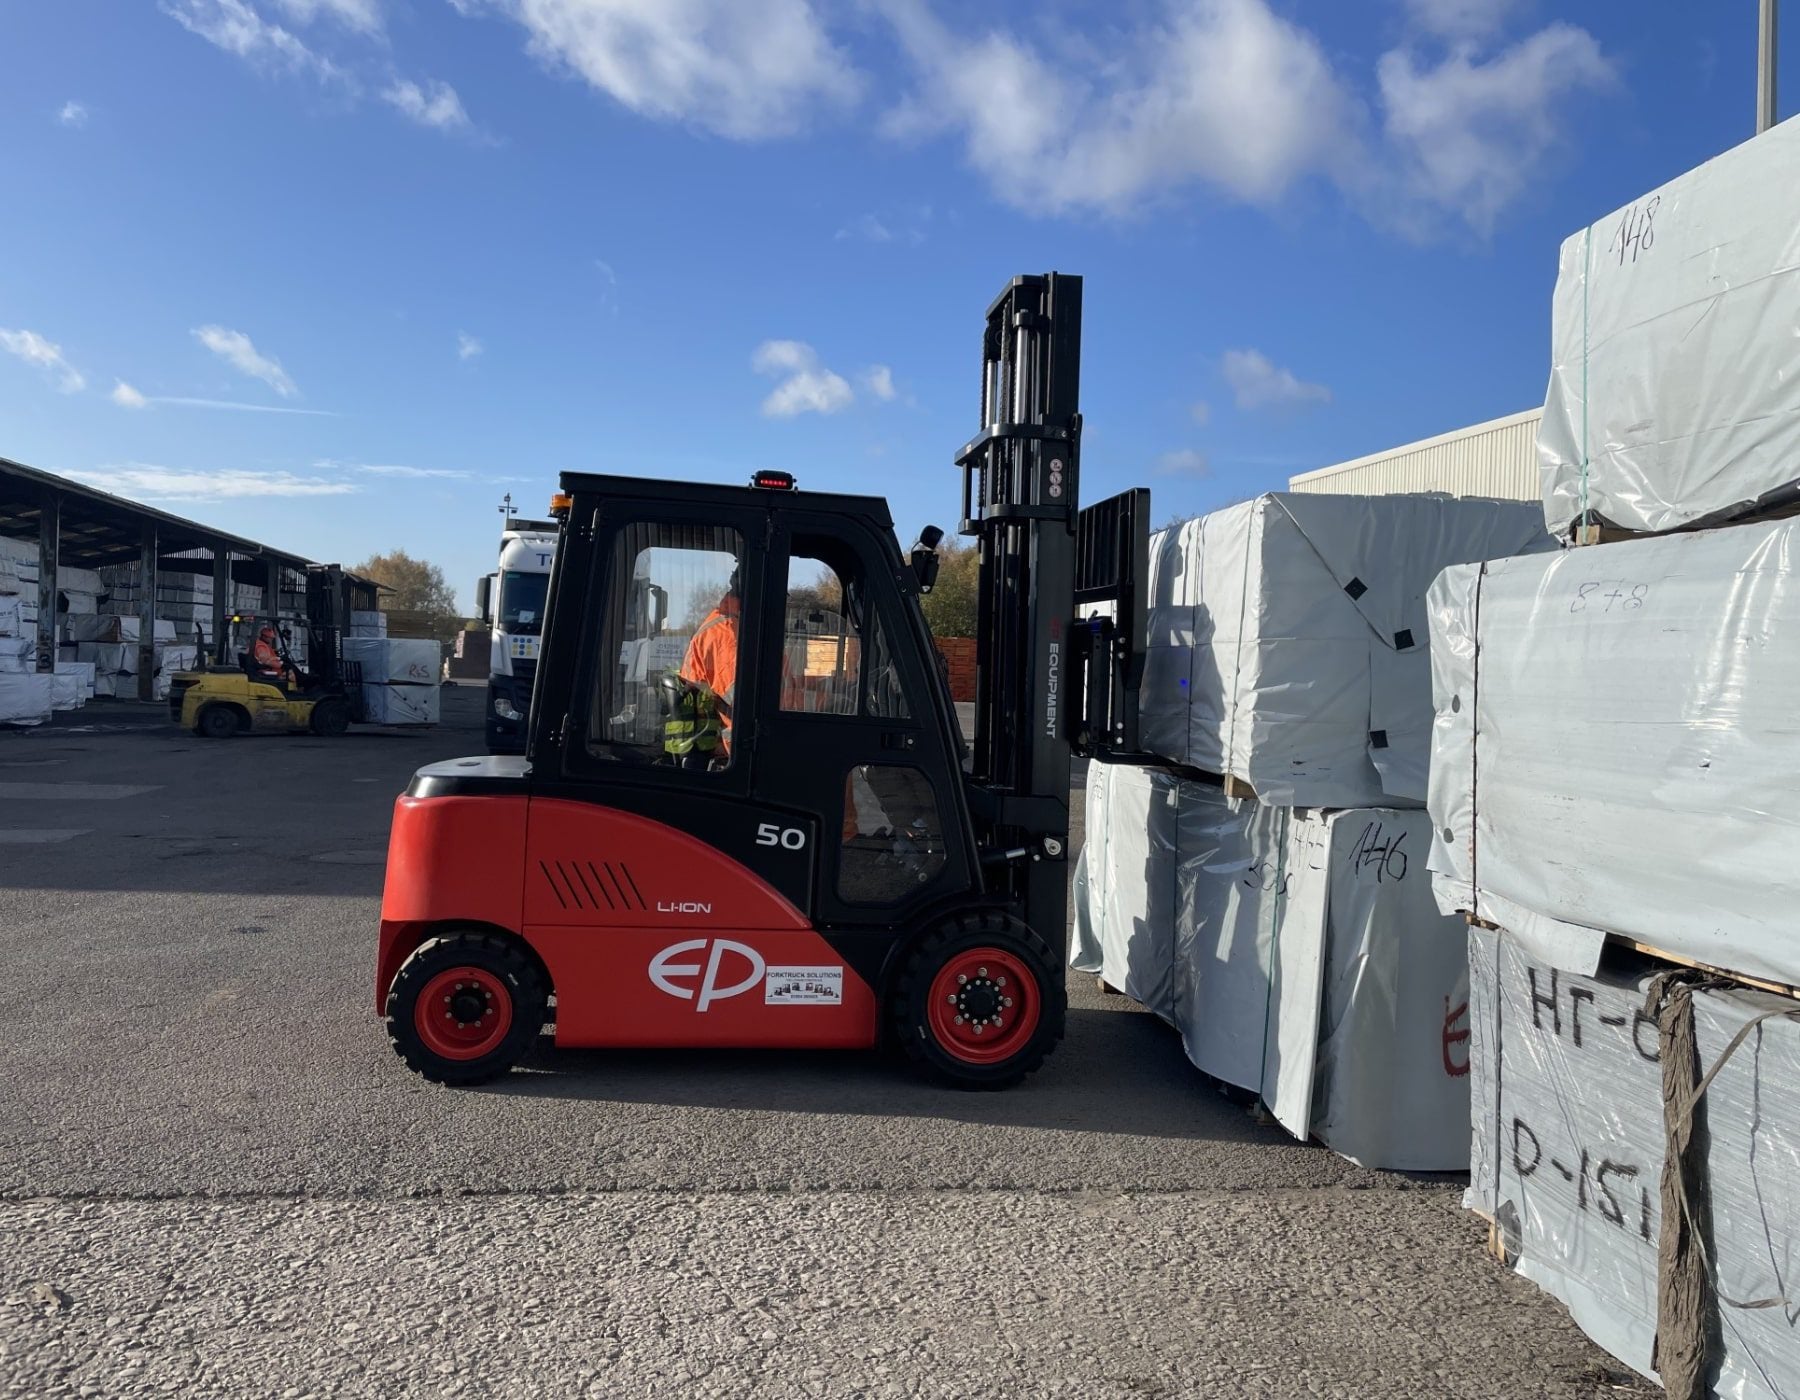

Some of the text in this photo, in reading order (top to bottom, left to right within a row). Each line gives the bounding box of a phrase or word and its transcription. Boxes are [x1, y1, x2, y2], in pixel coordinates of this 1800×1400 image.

[1609, 194, 1661, 267] 148
[1046, 643, 1059, 739] EQUIPMENT
[755, 823, 806, 850] 50
[1349, 821, 1407, 884] 146
[657, 902, 712, 914] LI-ION
[648, 938, 766, 1013] EP
